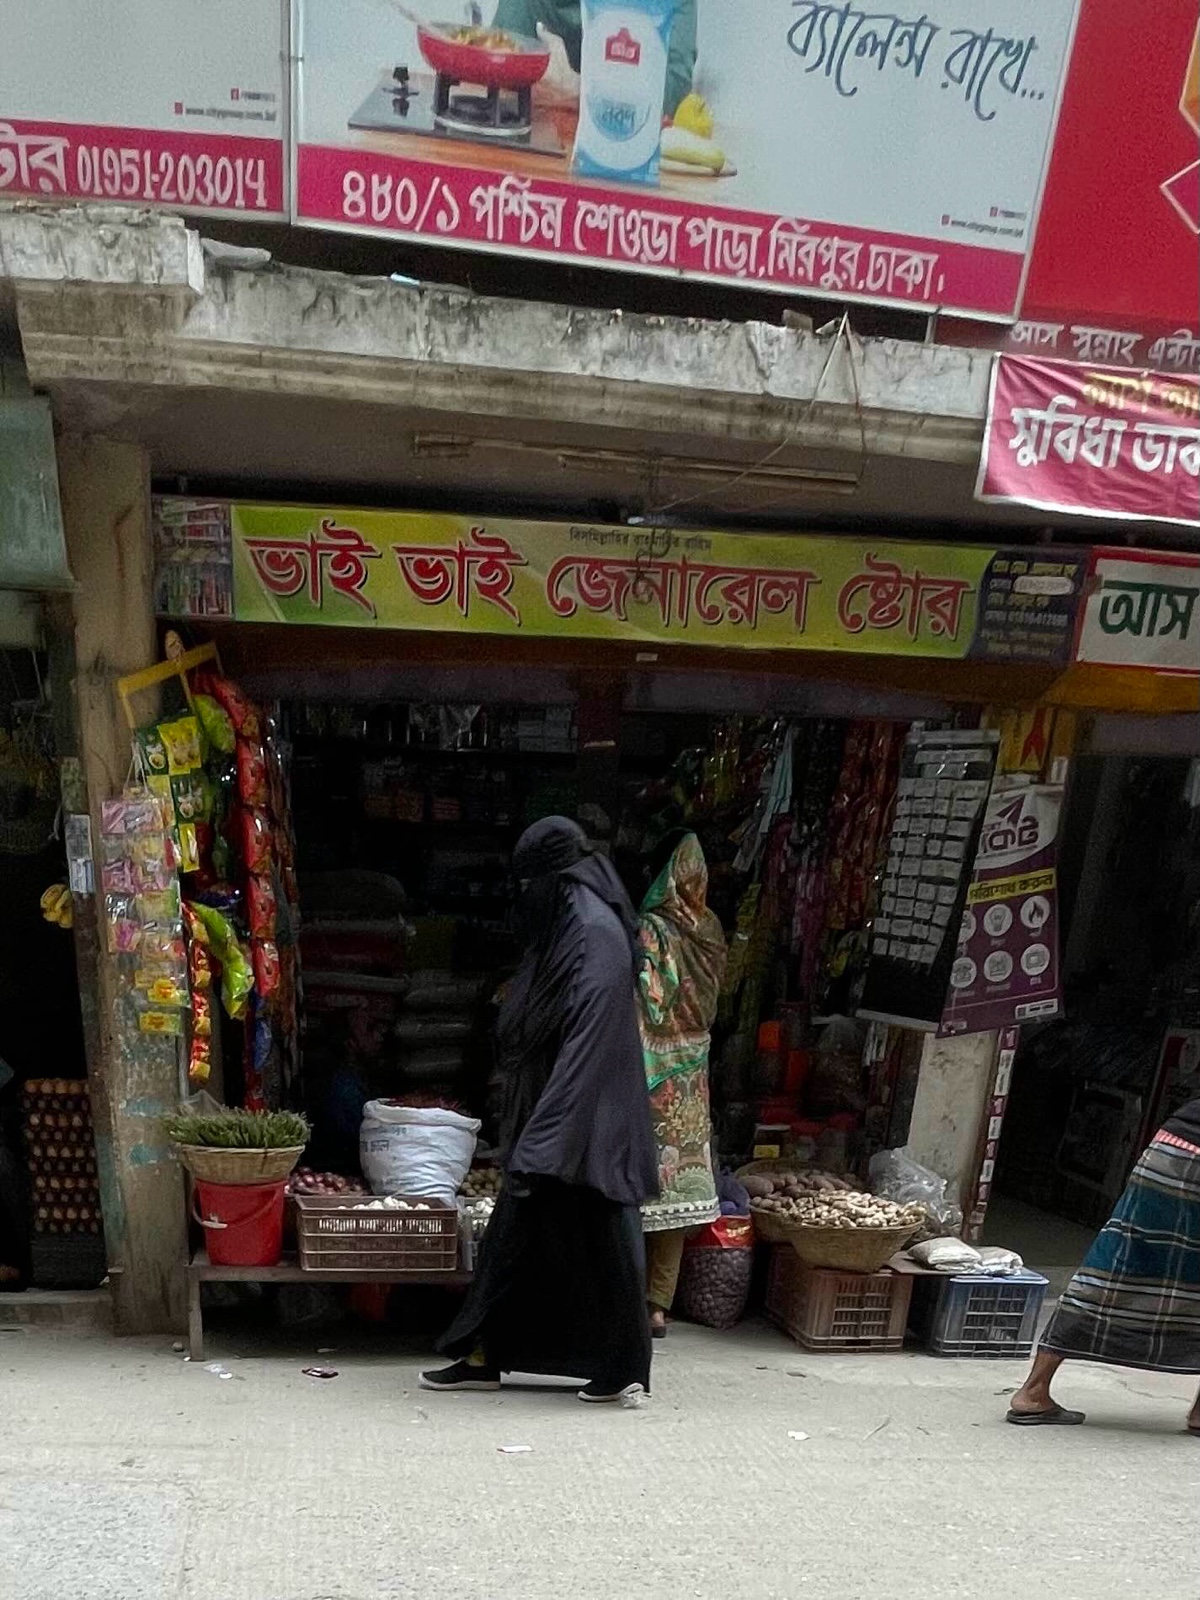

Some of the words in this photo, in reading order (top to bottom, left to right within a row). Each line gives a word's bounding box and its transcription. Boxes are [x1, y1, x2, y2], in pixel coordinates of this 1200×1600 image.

[787, 1, 941, 97] ব্যালেন্স
[77, 145, 268, 208] 01951-203014
[342, 170, 460, 232] ৪৮০/১
[469, 175, 567, 248] পশ্চিম
[1009, 395, 1127, 468] সুবিধা
[243, 518, 382, 619] ভাই
[391, 526, 530, 626] ভাই
[546, 554, 822, 634] জেনারেল
[837, 549, 976, 643] ষ্টোর
